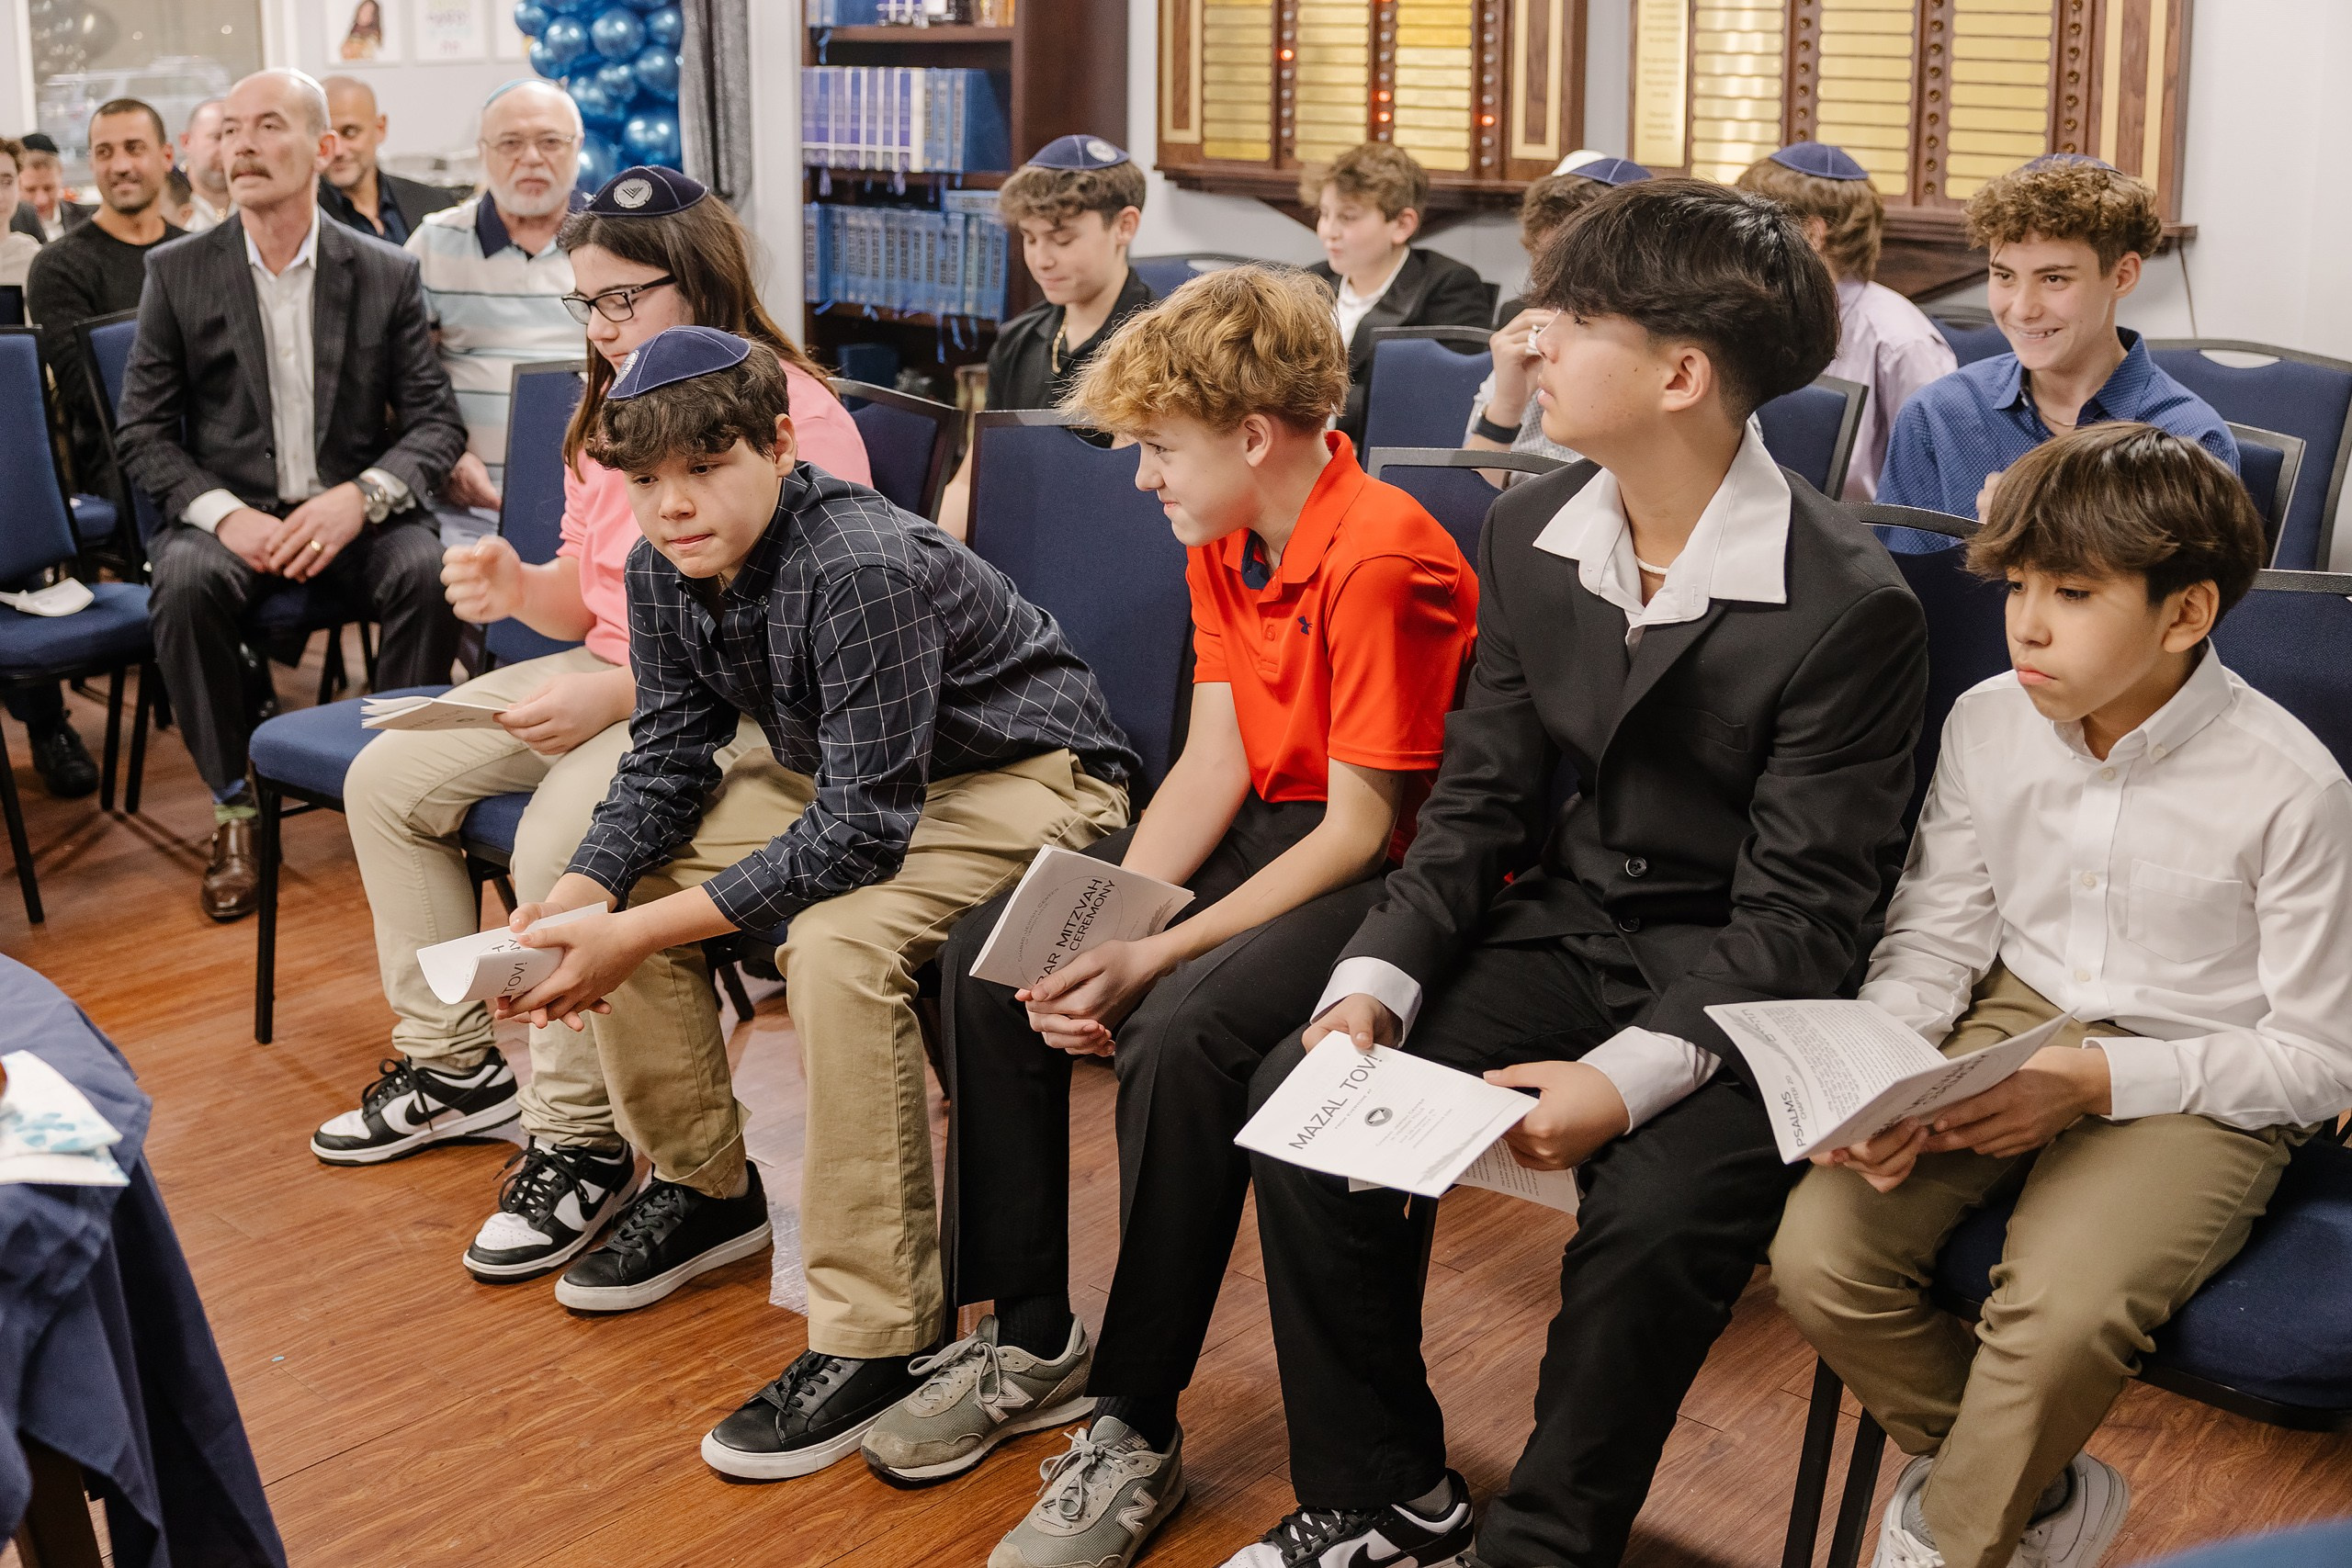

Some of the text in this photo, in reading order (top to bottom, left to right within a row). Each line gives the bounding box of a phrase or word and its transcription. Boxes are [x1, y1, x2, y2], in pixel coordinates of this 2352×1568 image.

[1056, 879, 1102, 947] MITZVAH
[1069, 880, 1115, 951] CEREMONY
[501, 962, 527, 994] TOV!
[1288, 1055, 1382, 1149] MAZAL TOV!
[1781, 1091, 1806, 1147] PSALMS
[1785, 1075, 1807, 1121] CHAPTER 20
